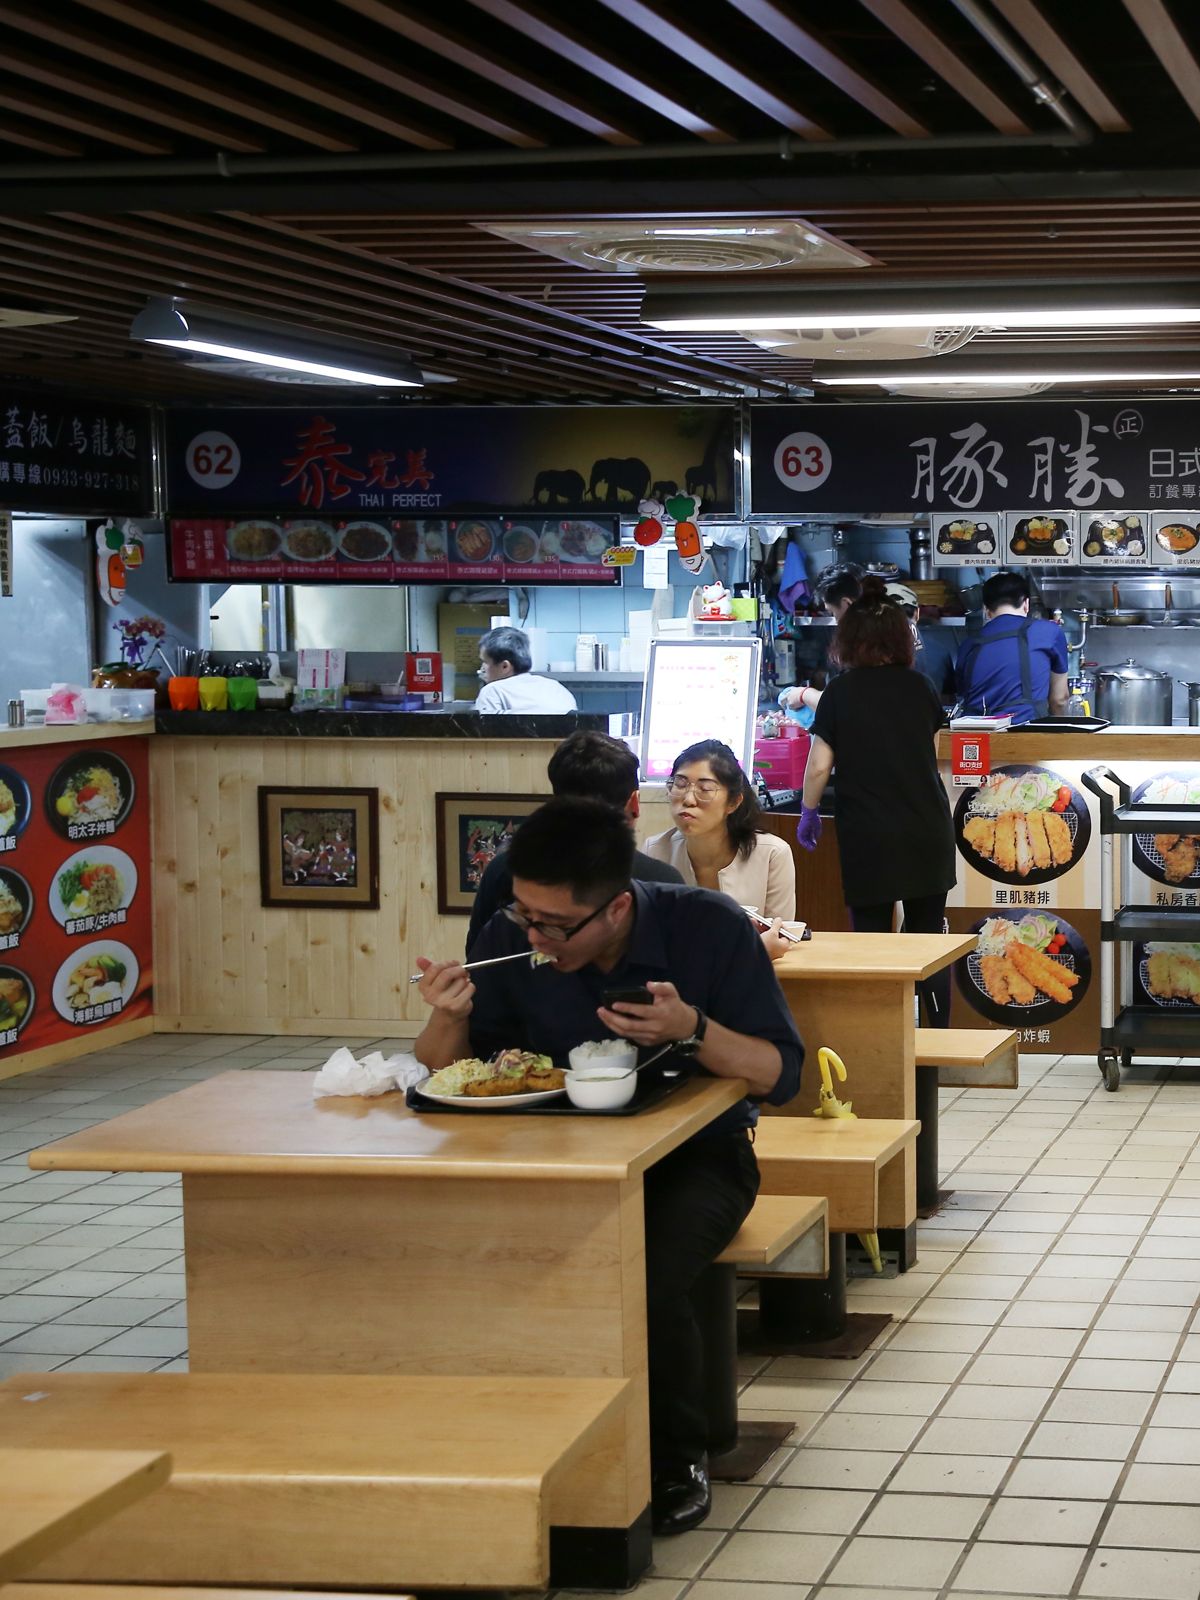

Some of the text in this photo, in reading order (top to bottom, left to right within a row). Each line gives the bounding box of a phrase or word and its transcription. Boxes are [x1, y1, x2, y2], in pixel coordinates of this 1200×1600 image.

[3, 405, 137, 459] 蓋飯/烏龍麵
[193, 444, 233, 475] 62
[781, 445, 824, 477] 63
[909, 409, 1125, 509] 豚勝
[358, 494, 442, 507] THAI PERFECT
[68, 821, 116, 839] 明太子拌麵
[995, 889, 1050, 905] 里肌豬排
